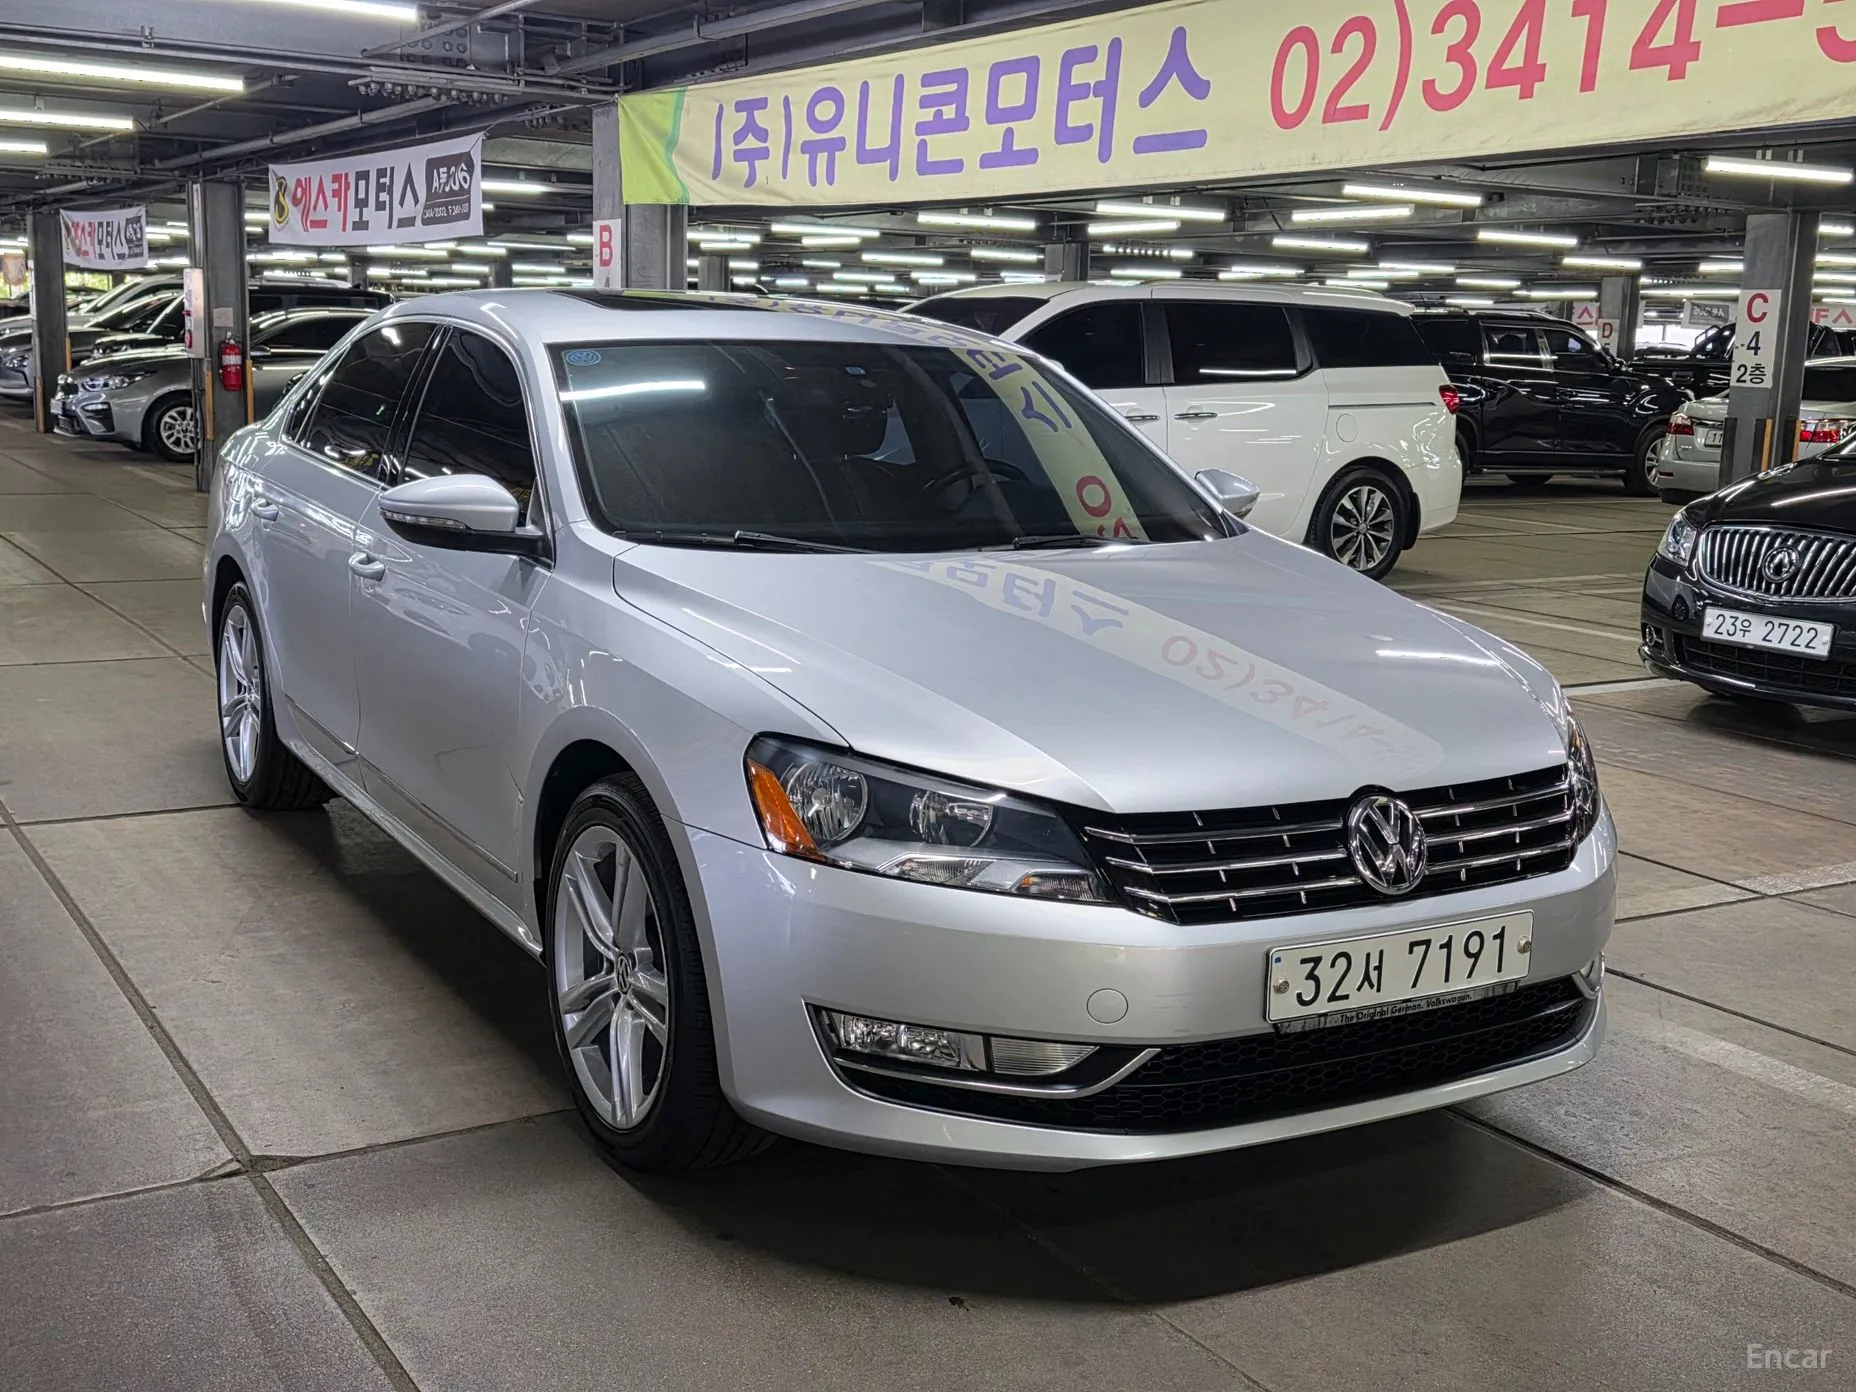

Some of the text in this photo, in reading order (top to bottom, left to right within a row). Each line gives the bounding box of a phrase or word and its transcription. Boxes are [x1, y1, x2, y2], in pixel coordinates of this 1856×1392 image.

[711, 25, 1211, 189] (주)유니콘모터스
[599, 224, 613, 267] B
[1747, 293, 1769, 323] C
[1602, 322, 1613, 338] D
[1746, 331, 1761, 356] 4
[1736, 363, 1766, 384] 2층
[1714, 613, 1819, 650] 23우 2722
[1296, 925, 1506, 1007] 32서 7191
[1339, 1014, 1354, 1024] The
[1356, 1008, 1389, 1021] Original
